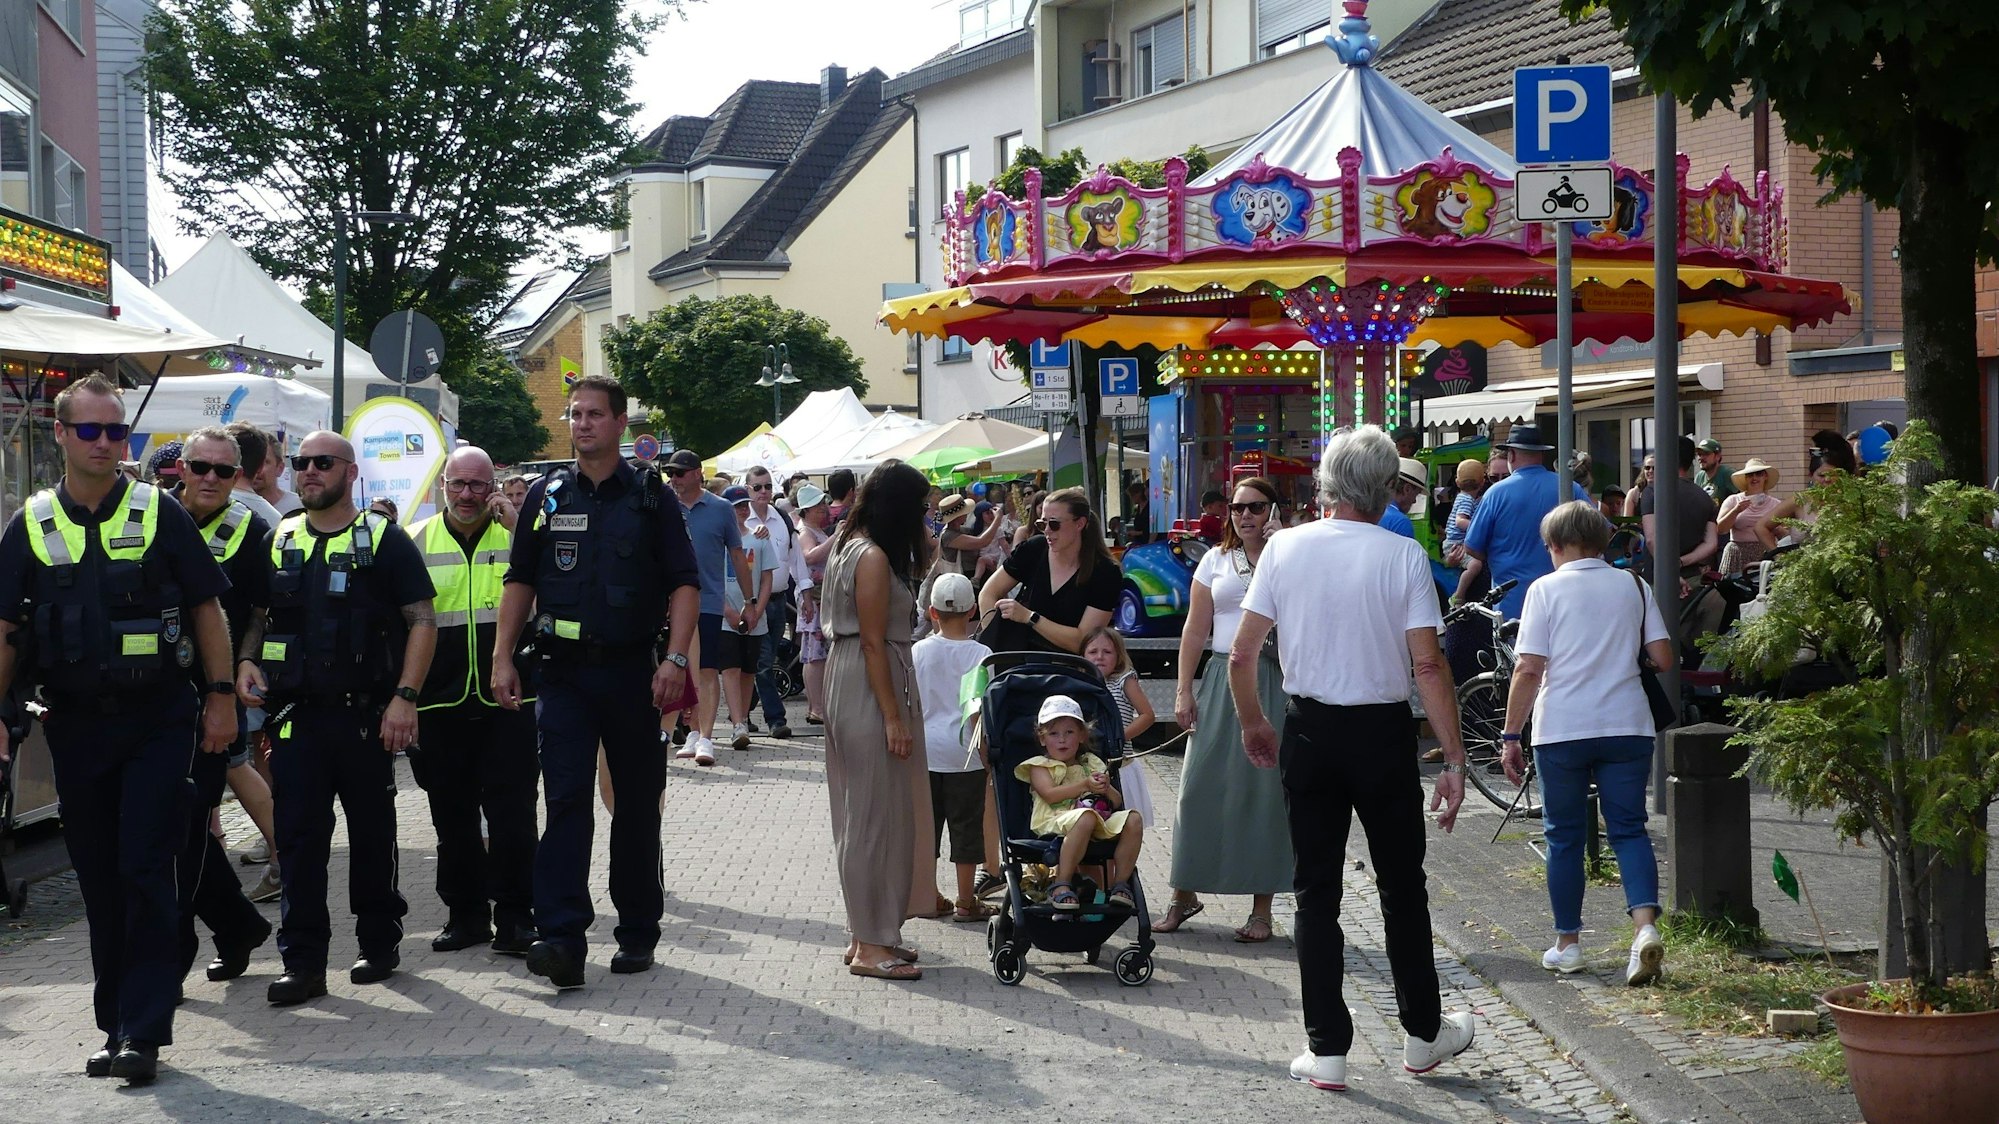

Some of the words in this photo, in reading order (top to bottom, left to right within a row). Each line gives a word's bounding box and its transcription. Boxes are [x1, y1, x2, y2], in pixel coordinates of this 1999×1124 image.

[1537, 79, 1588, 151] P
[1108, 363, 1129, 393] P
[203, 396, 222, 404] stadt
[364, 435, 399, 444] Kampagne
[369, 480, 387, 492] WIR
[390, 478, 411, 490] SIND
[552, 517, 586, 528] ORDNUNGSAMT
[112, 538, 143, 548] ORDNUNGSAMT
